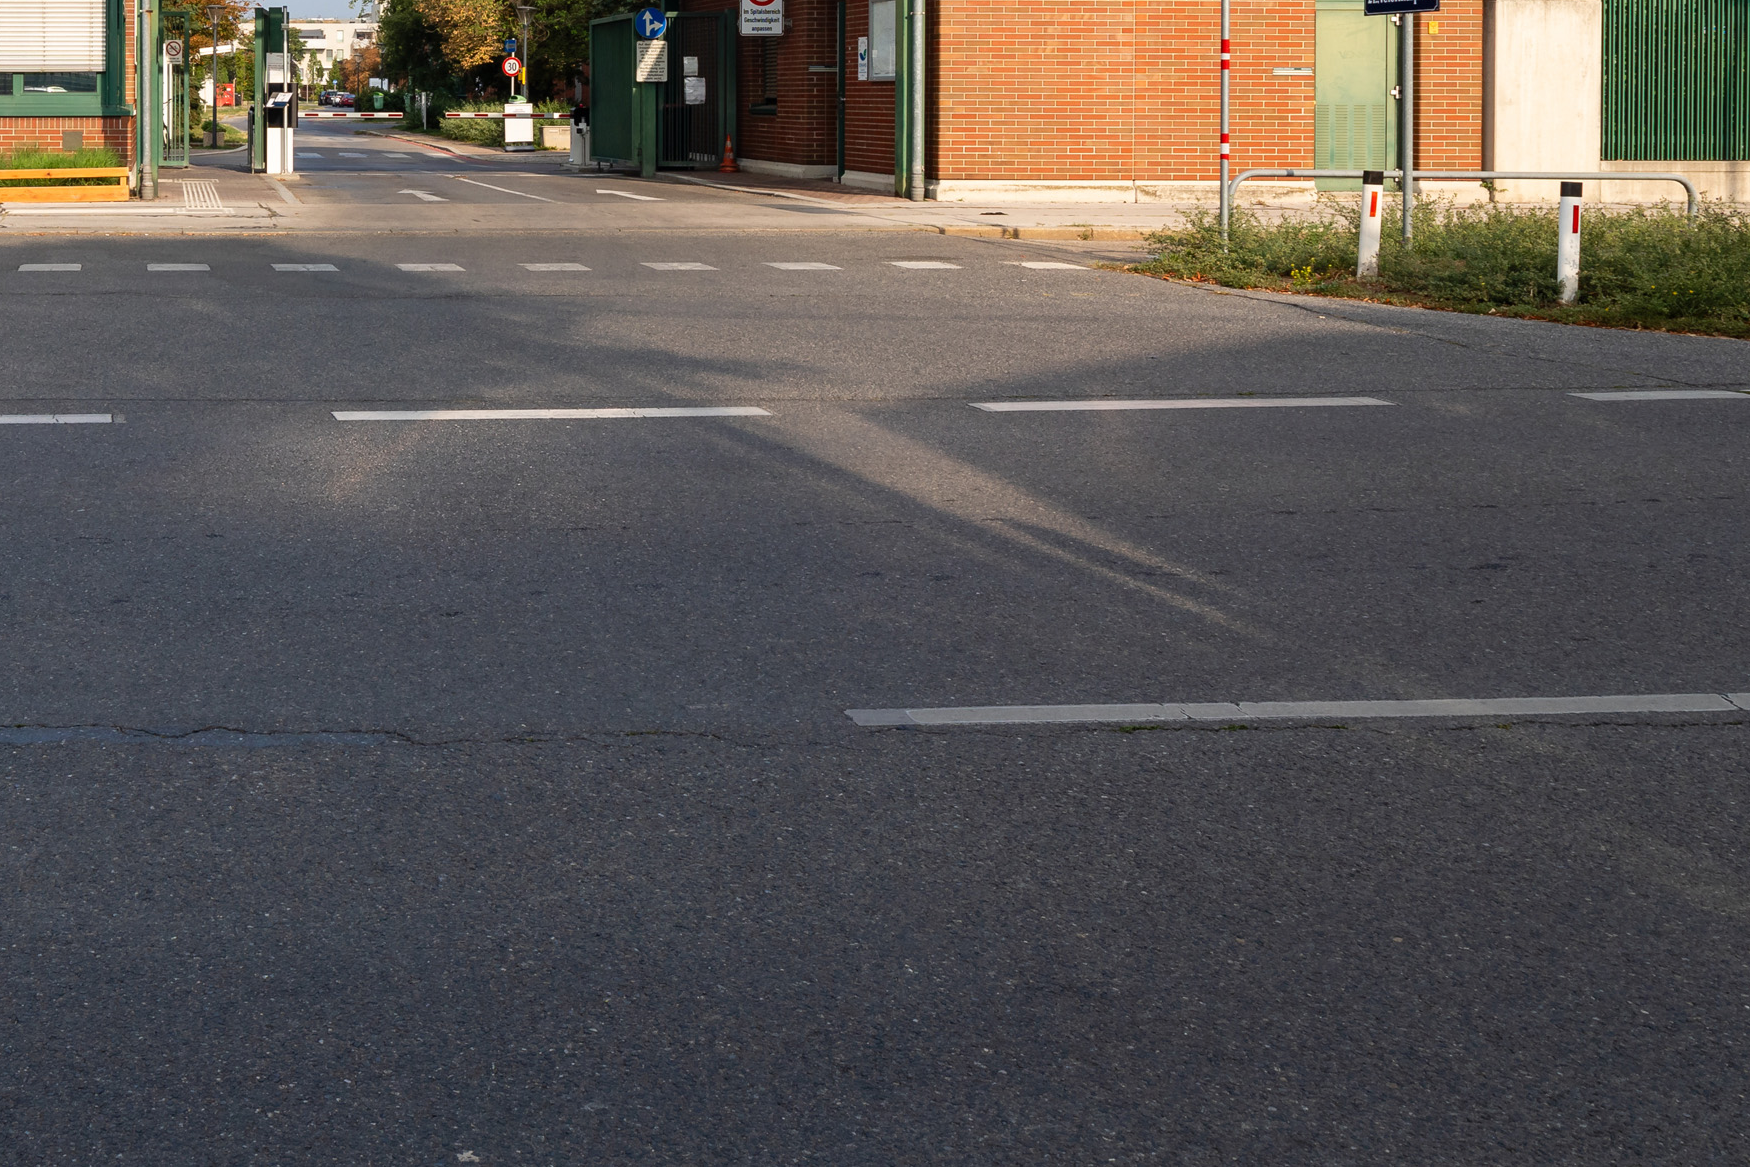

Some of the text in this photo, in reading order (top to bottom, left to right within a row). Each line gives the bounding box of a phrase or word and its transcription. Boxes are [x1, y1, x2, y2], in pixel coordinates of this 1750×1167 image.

[750, 8, 781, 16] Spitalsbereich
[744, 16, 780, 24] Geschwindigkeit
[507, 62, 517, 72] 30
